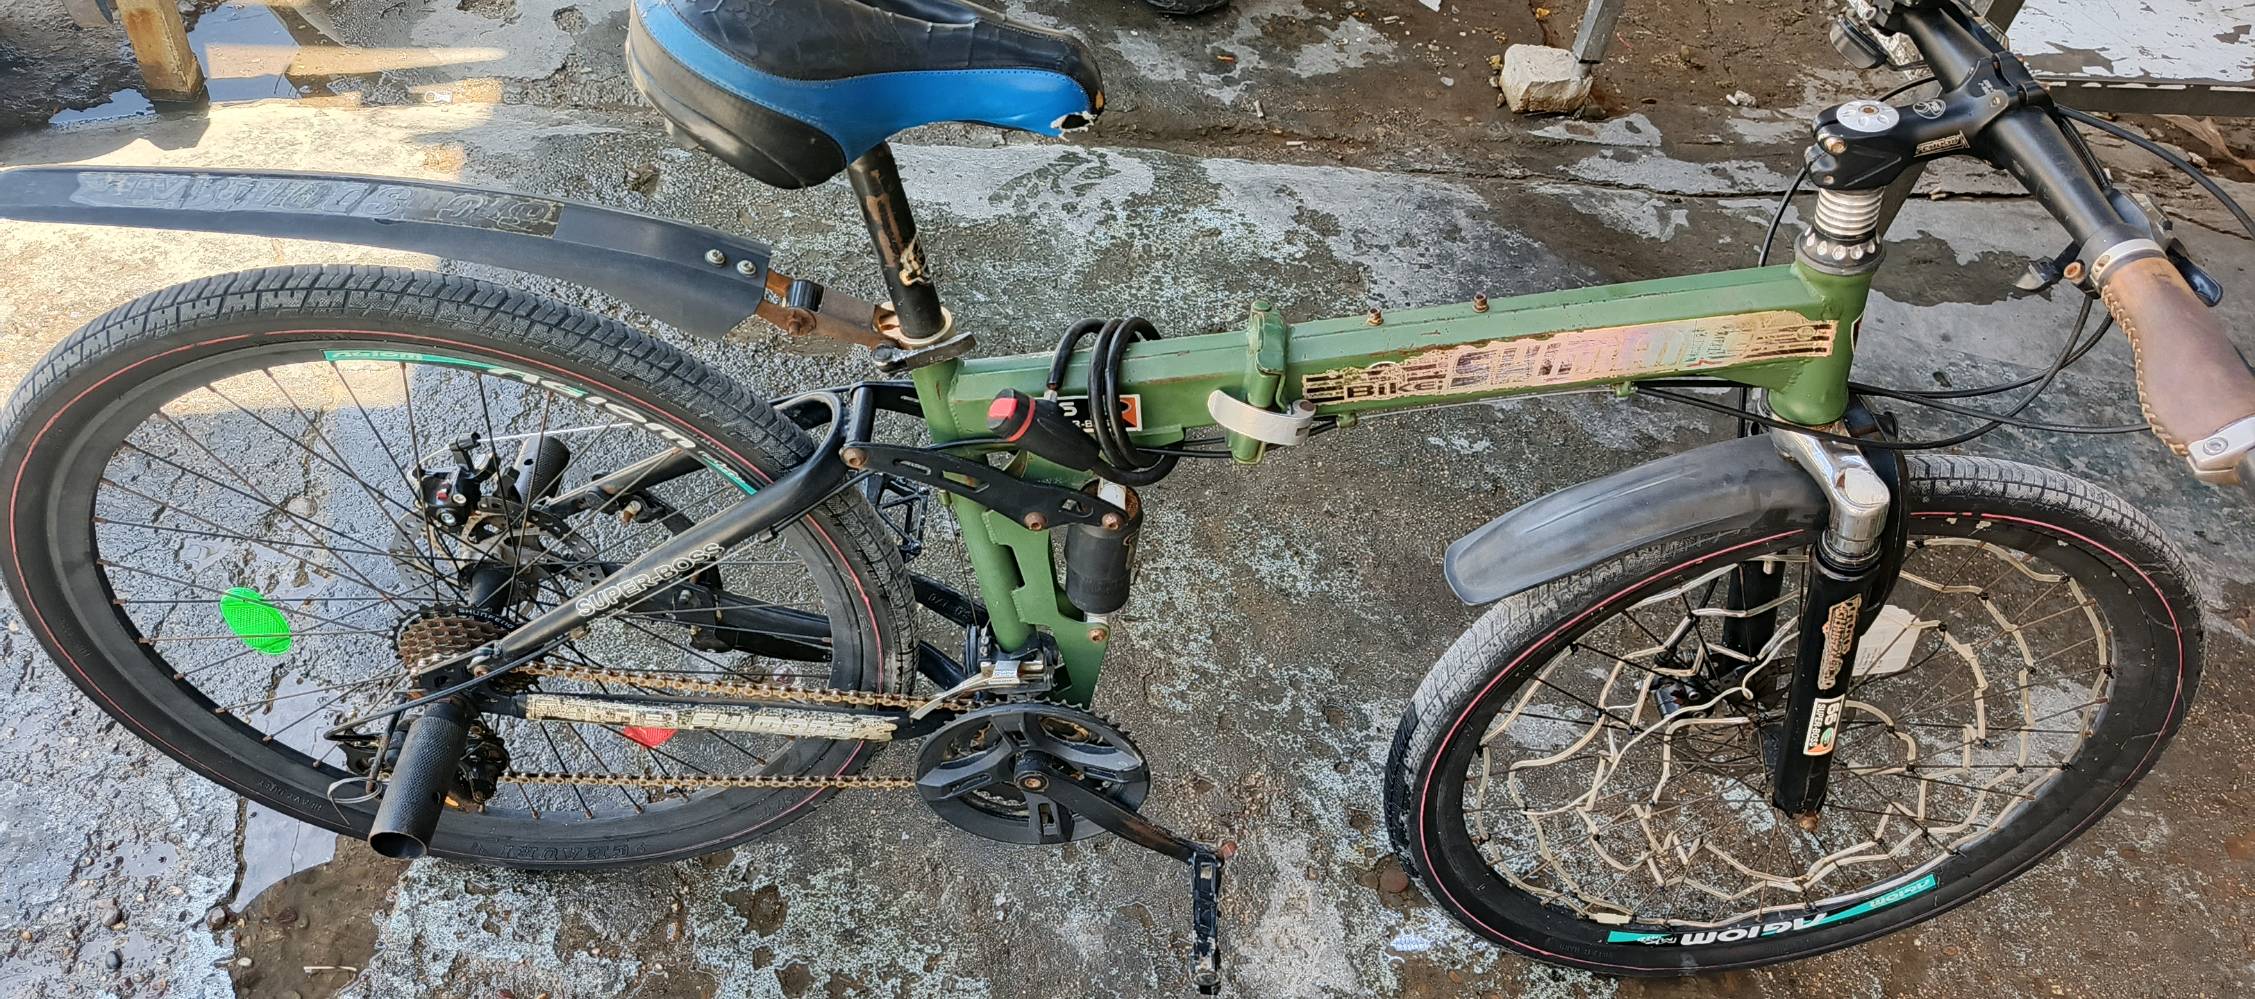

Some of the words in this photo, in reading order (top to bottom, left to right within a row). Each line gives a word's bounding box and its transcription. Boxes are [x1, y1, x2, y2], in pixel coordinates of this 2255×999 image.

[575, 542, 726, 617] SUPER-BOSS
[1808, 703, 1826, 747] SUPER-BOSS
[1680, 911, 1829, 947] AGIOM
